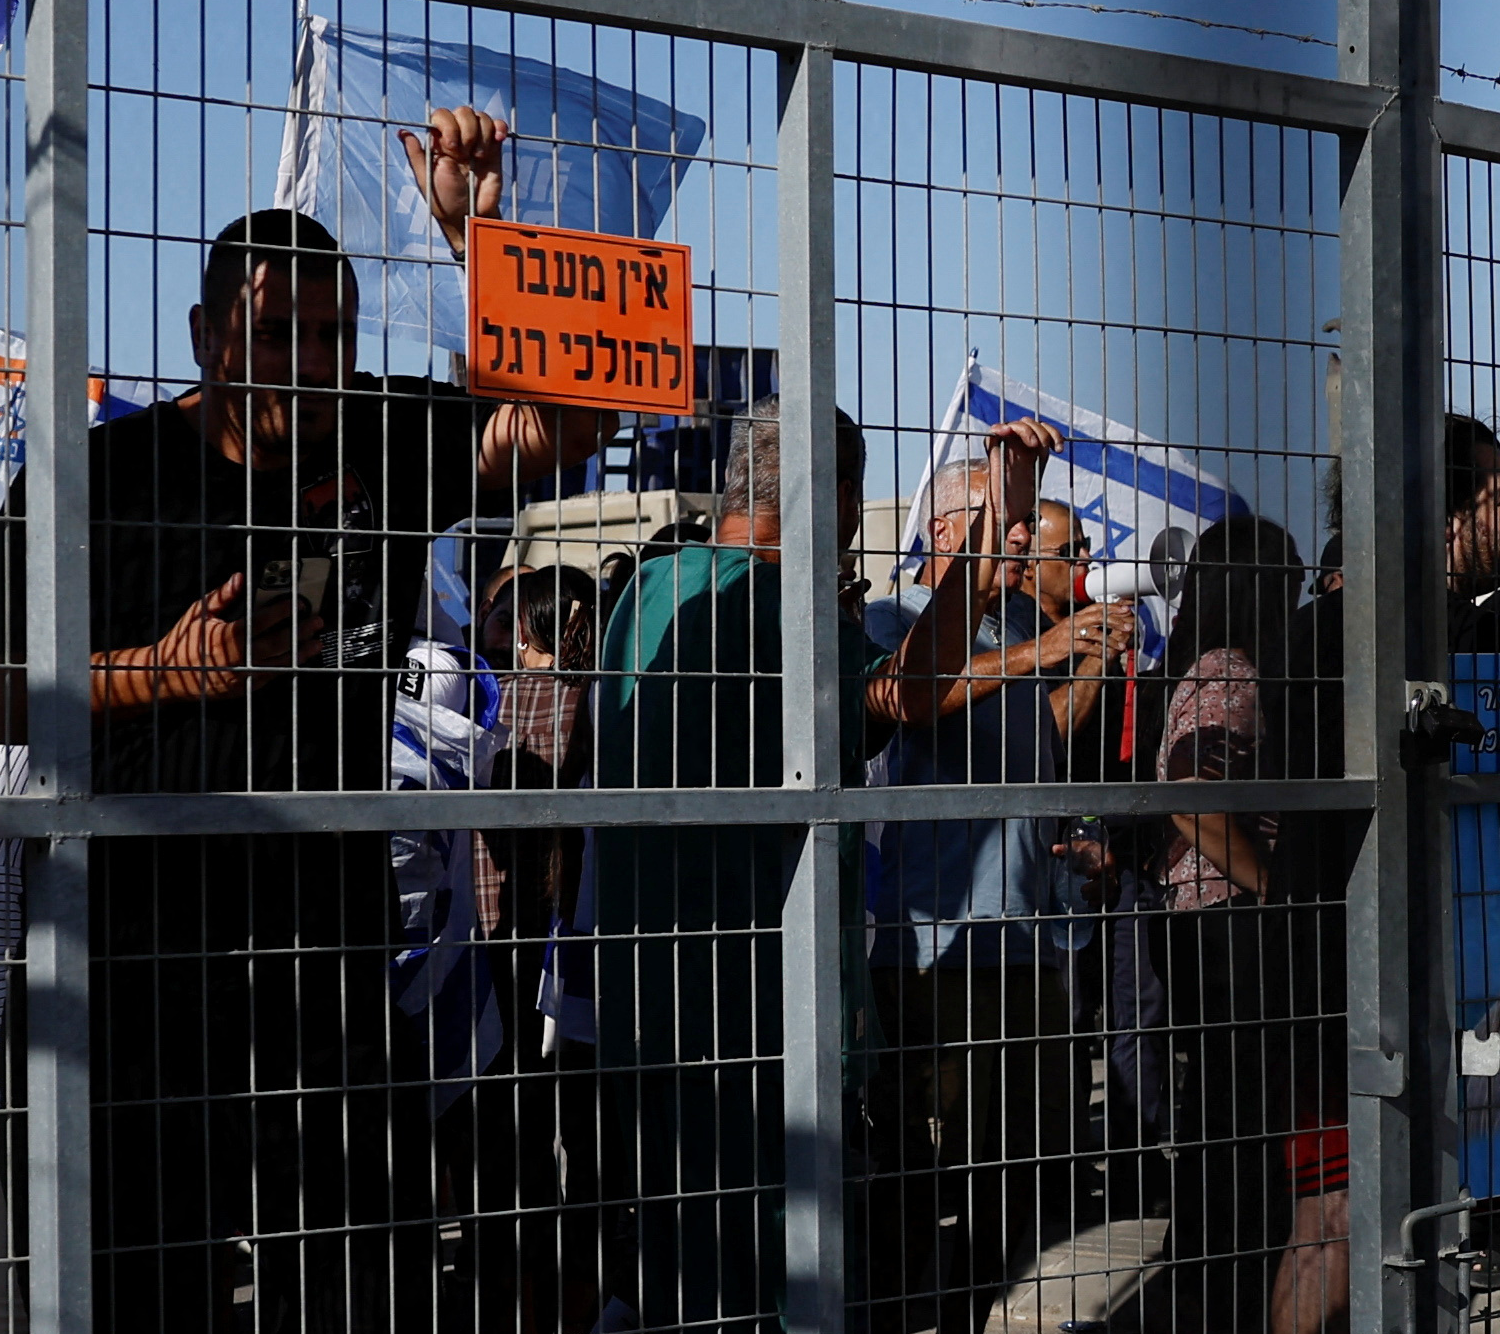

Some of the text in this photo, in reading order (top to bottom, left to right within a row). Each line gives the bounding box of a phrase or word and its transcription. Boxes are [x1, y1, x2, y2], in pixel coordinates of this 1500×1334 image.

[503, 244, 670, 315] אין מעבר
[481, 316, 682, 390] להולכי רגל
